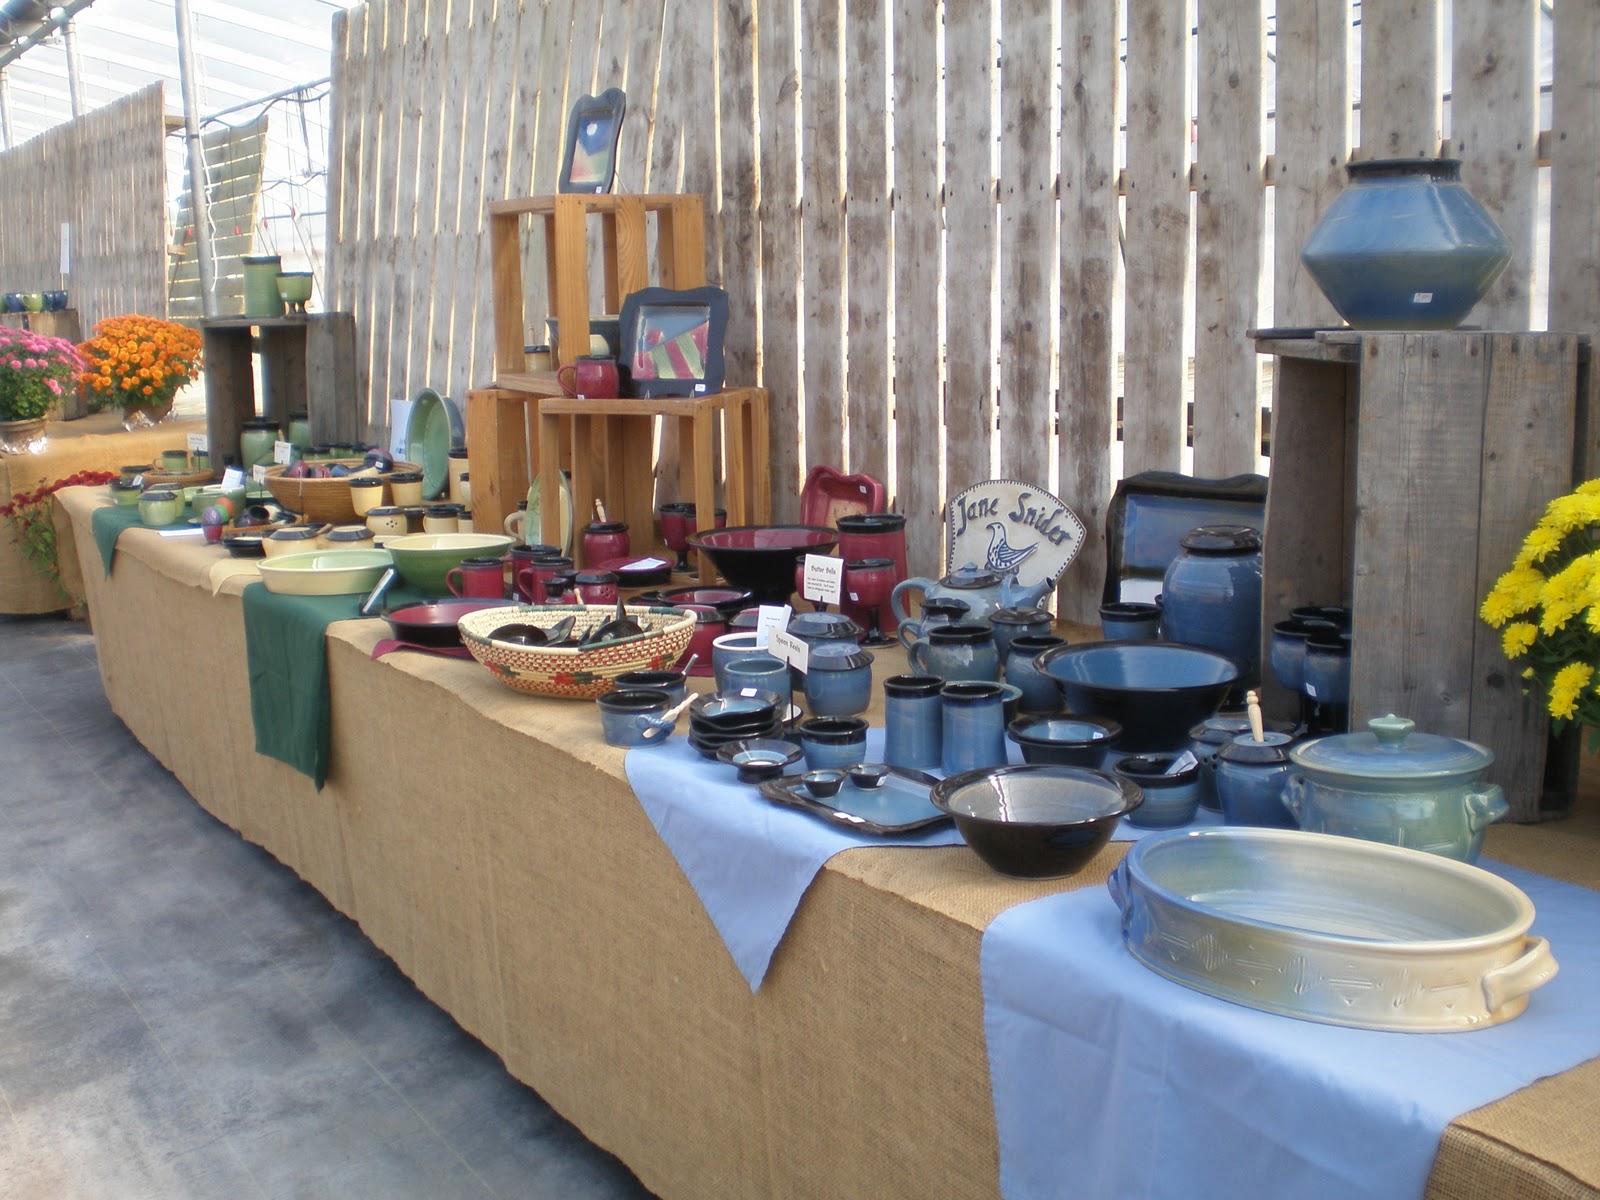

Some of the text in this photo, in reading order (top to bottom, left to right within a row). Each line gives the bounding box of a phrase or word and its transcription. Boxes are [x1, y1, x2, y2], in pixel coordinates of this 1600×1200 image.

[957, 492, 1073, 545] Jane Snider
[775, 634, 789, 647] Spoon
